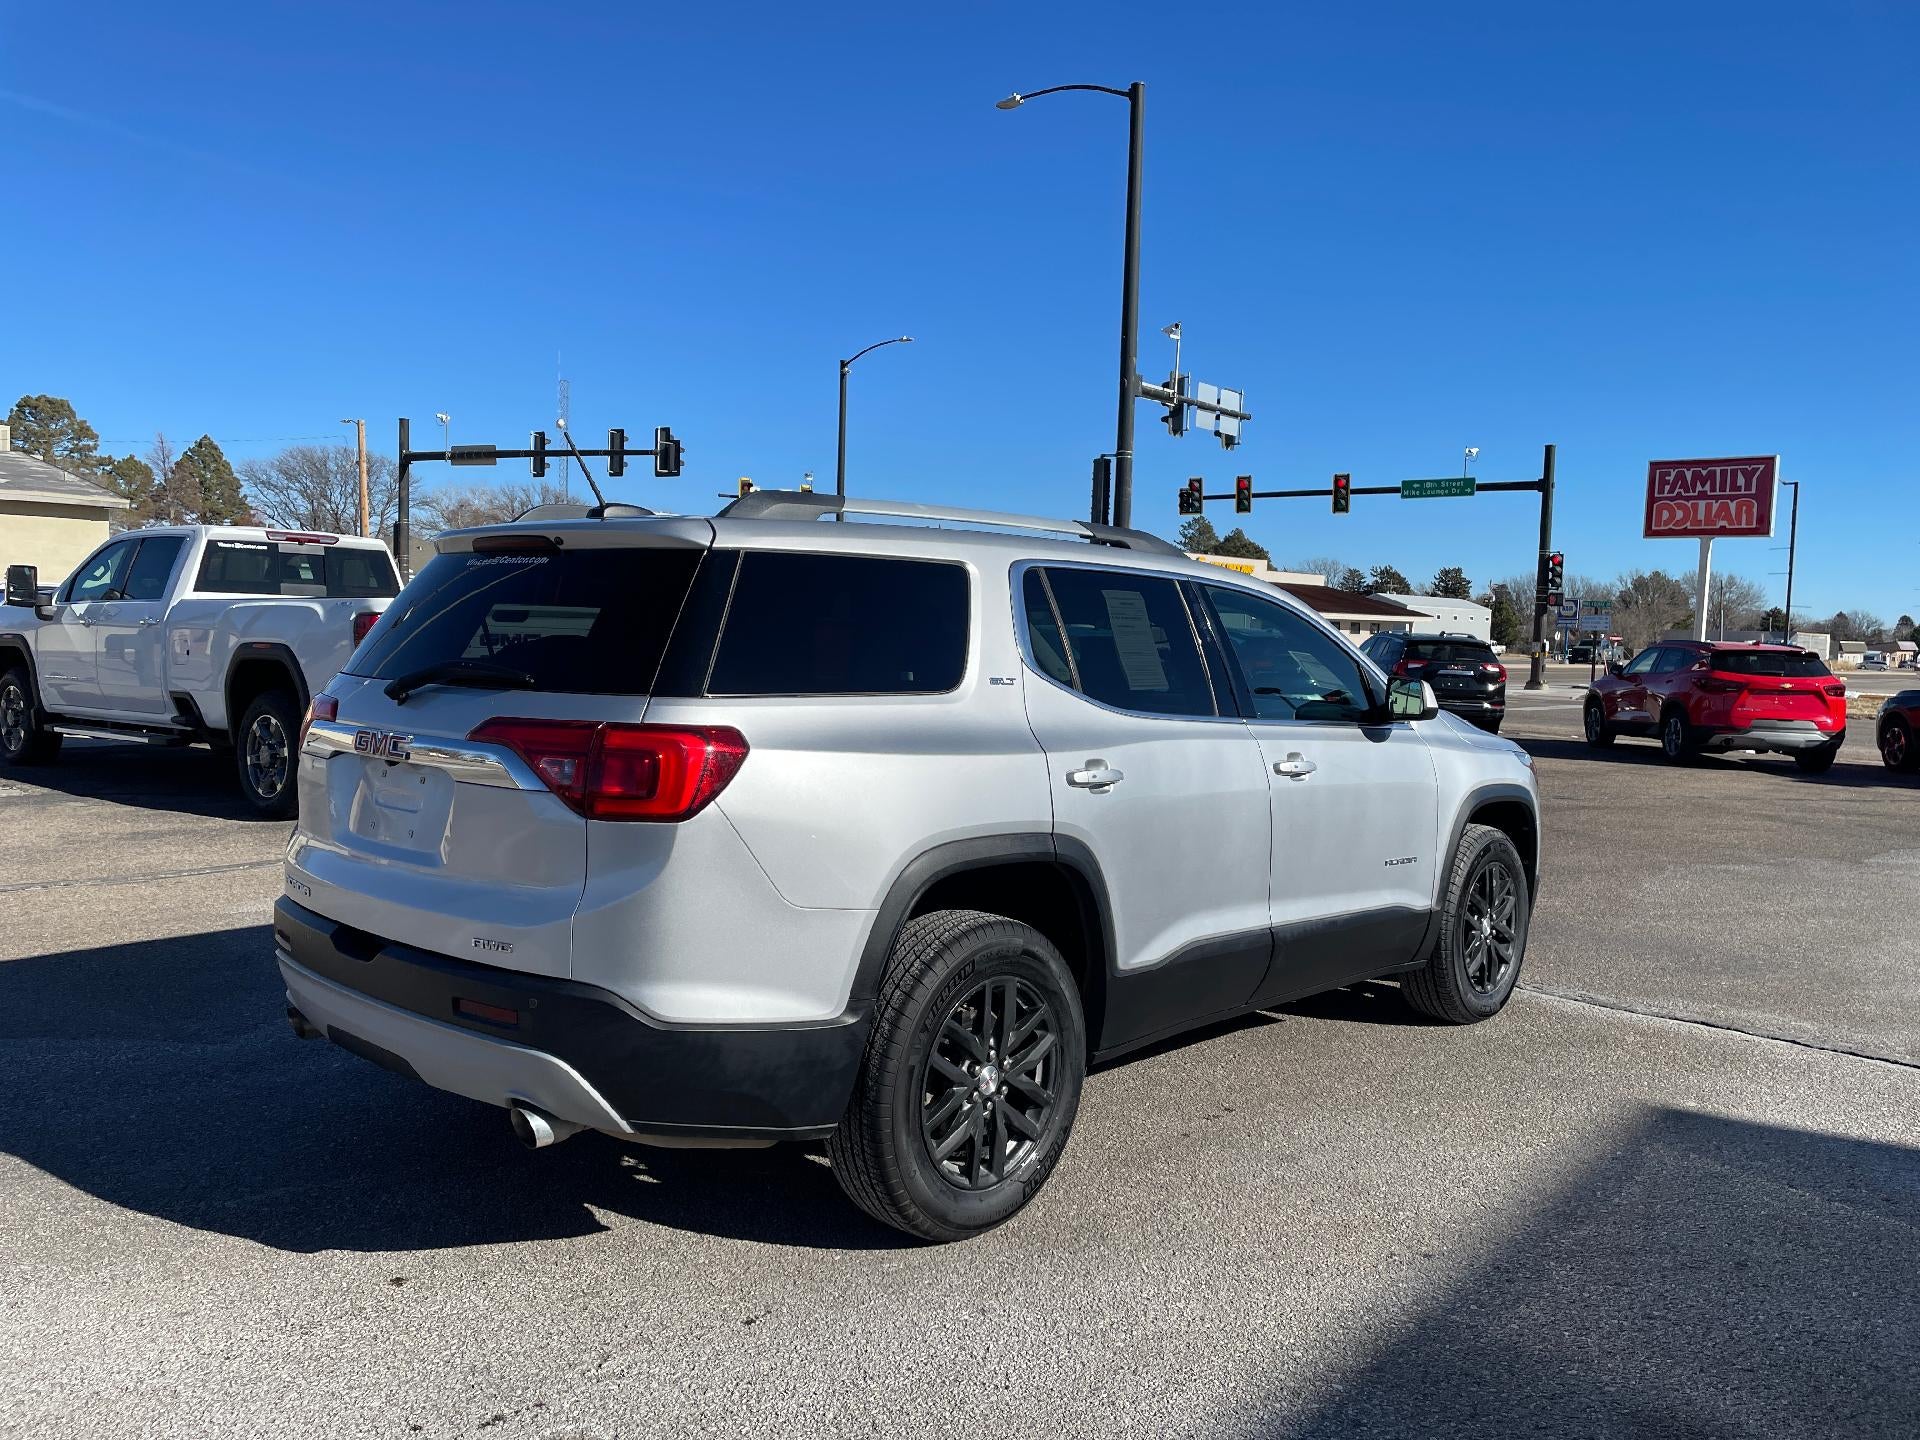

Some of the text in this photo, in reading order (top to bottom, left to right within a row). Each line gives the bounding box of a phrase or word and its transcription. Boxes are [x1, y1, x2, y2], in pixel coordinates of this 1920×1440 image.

[1440, 480, 1464, 488] Street
[1655, 465, 1765, 497] FAMILY
[1652, 498, 1757, 530] DOLLAR
[354, 729, 412, 761] GMC
[924, 959, 976, 1032] MICHELIN
